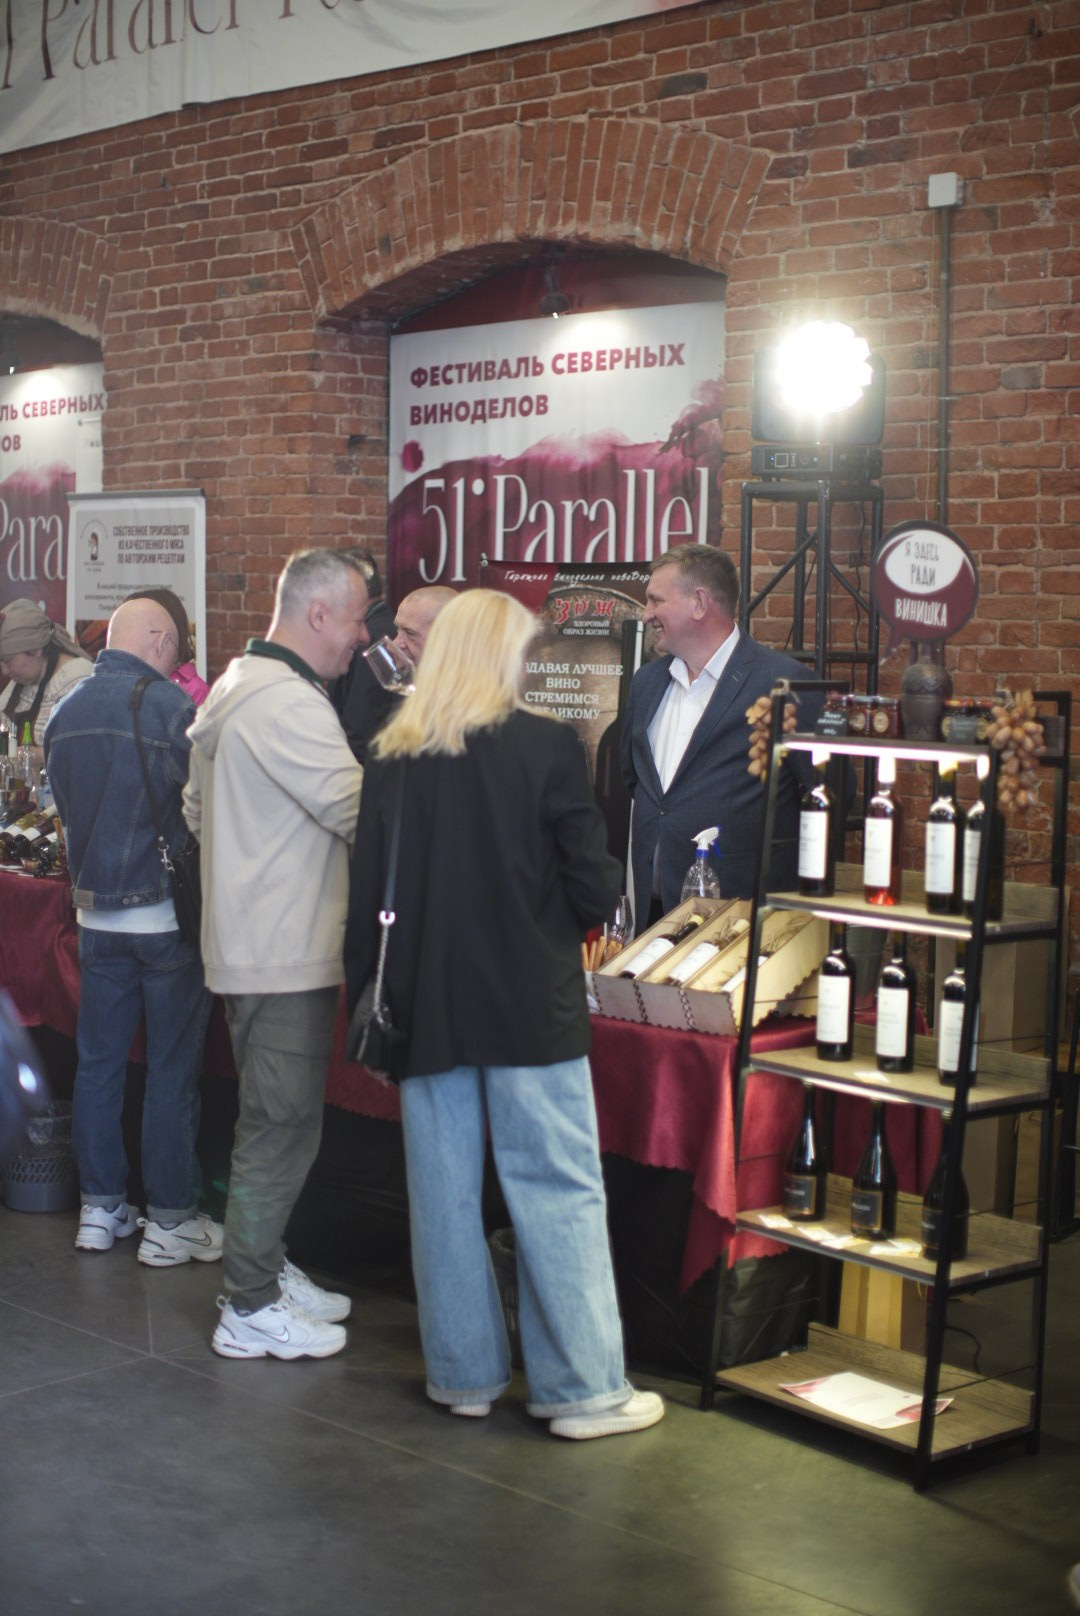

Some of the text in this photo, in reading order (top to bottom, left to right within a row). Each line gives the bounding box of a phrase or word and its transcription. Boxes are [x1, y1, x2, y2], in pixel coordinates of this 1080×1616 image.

[410, 343, 685, 388] ФЕСТИВАЛЬ СЕВЕРНЫХ
[22, 393, 104, 419] СЕВЕРНЫХ
[410, 394, 549, 426] ВИНОДЕЛОВ
[493, 467, 709, 563] Parallel
[905, 541, 940, 561] Я ЗДЕСЬ
[911, 564, 936, 587] РАДИ
[553, 597, 615, 625] ЗОЖ
[896, 598, 947, 627] ВИНИШКА
[572, 663, 624, 676] ЛУЧШЕЕ
[546, 677, 581, 689] ВИНО
[525, 691, 600, 705] СТРЕМИМСЯ
